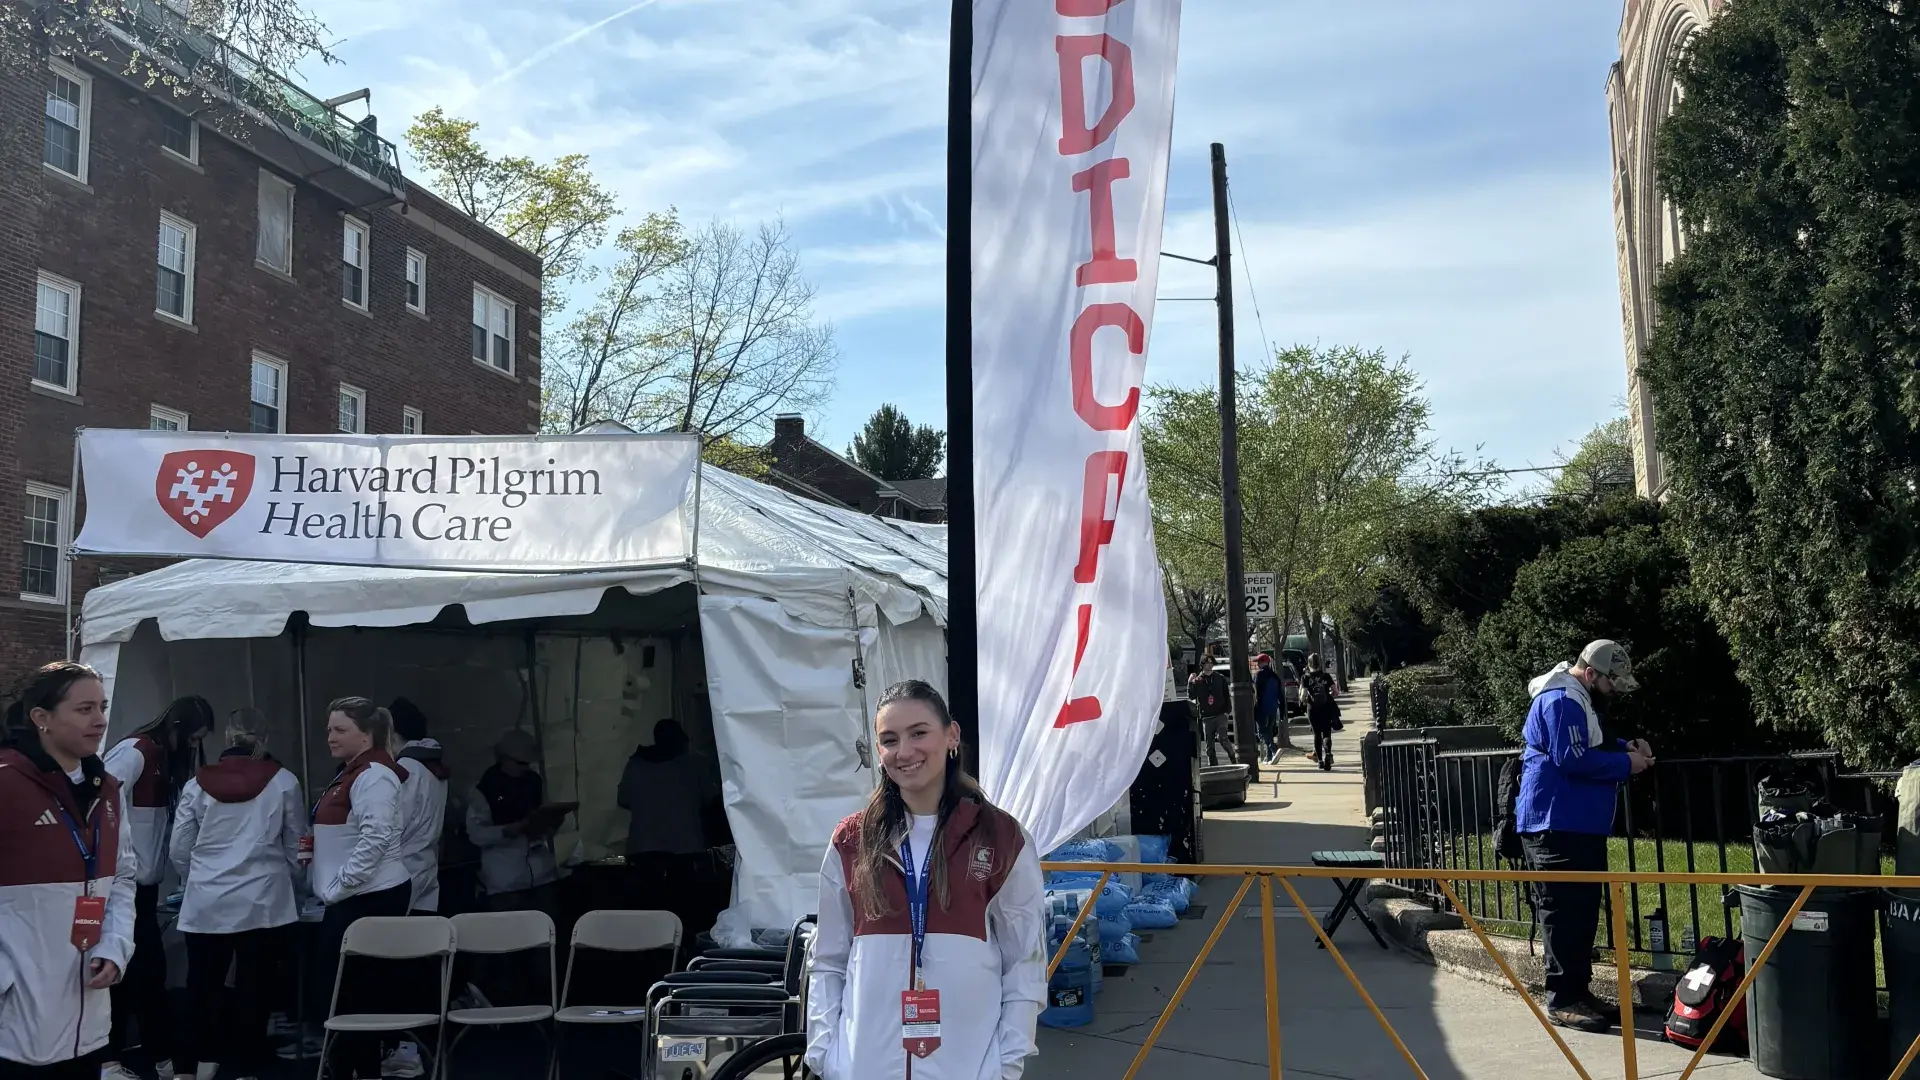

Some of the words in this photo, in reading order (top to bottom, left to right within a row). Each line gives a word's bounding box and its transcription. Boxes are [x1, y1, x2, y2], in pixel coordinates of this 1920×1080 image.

[1053, 0, 1145, 729] DICAL
[269, 455, 438, 495] Harvard
[446, 456, 603, 508] Pilgrim
[258, 500, 404, 540] Health
[411, 502, 513, 542] Care
[1245, 586, 1267, 594] LIMIT
[1245, 595, 1270, 612] 25
[664, 1042, 704, 1058] TUFFY
